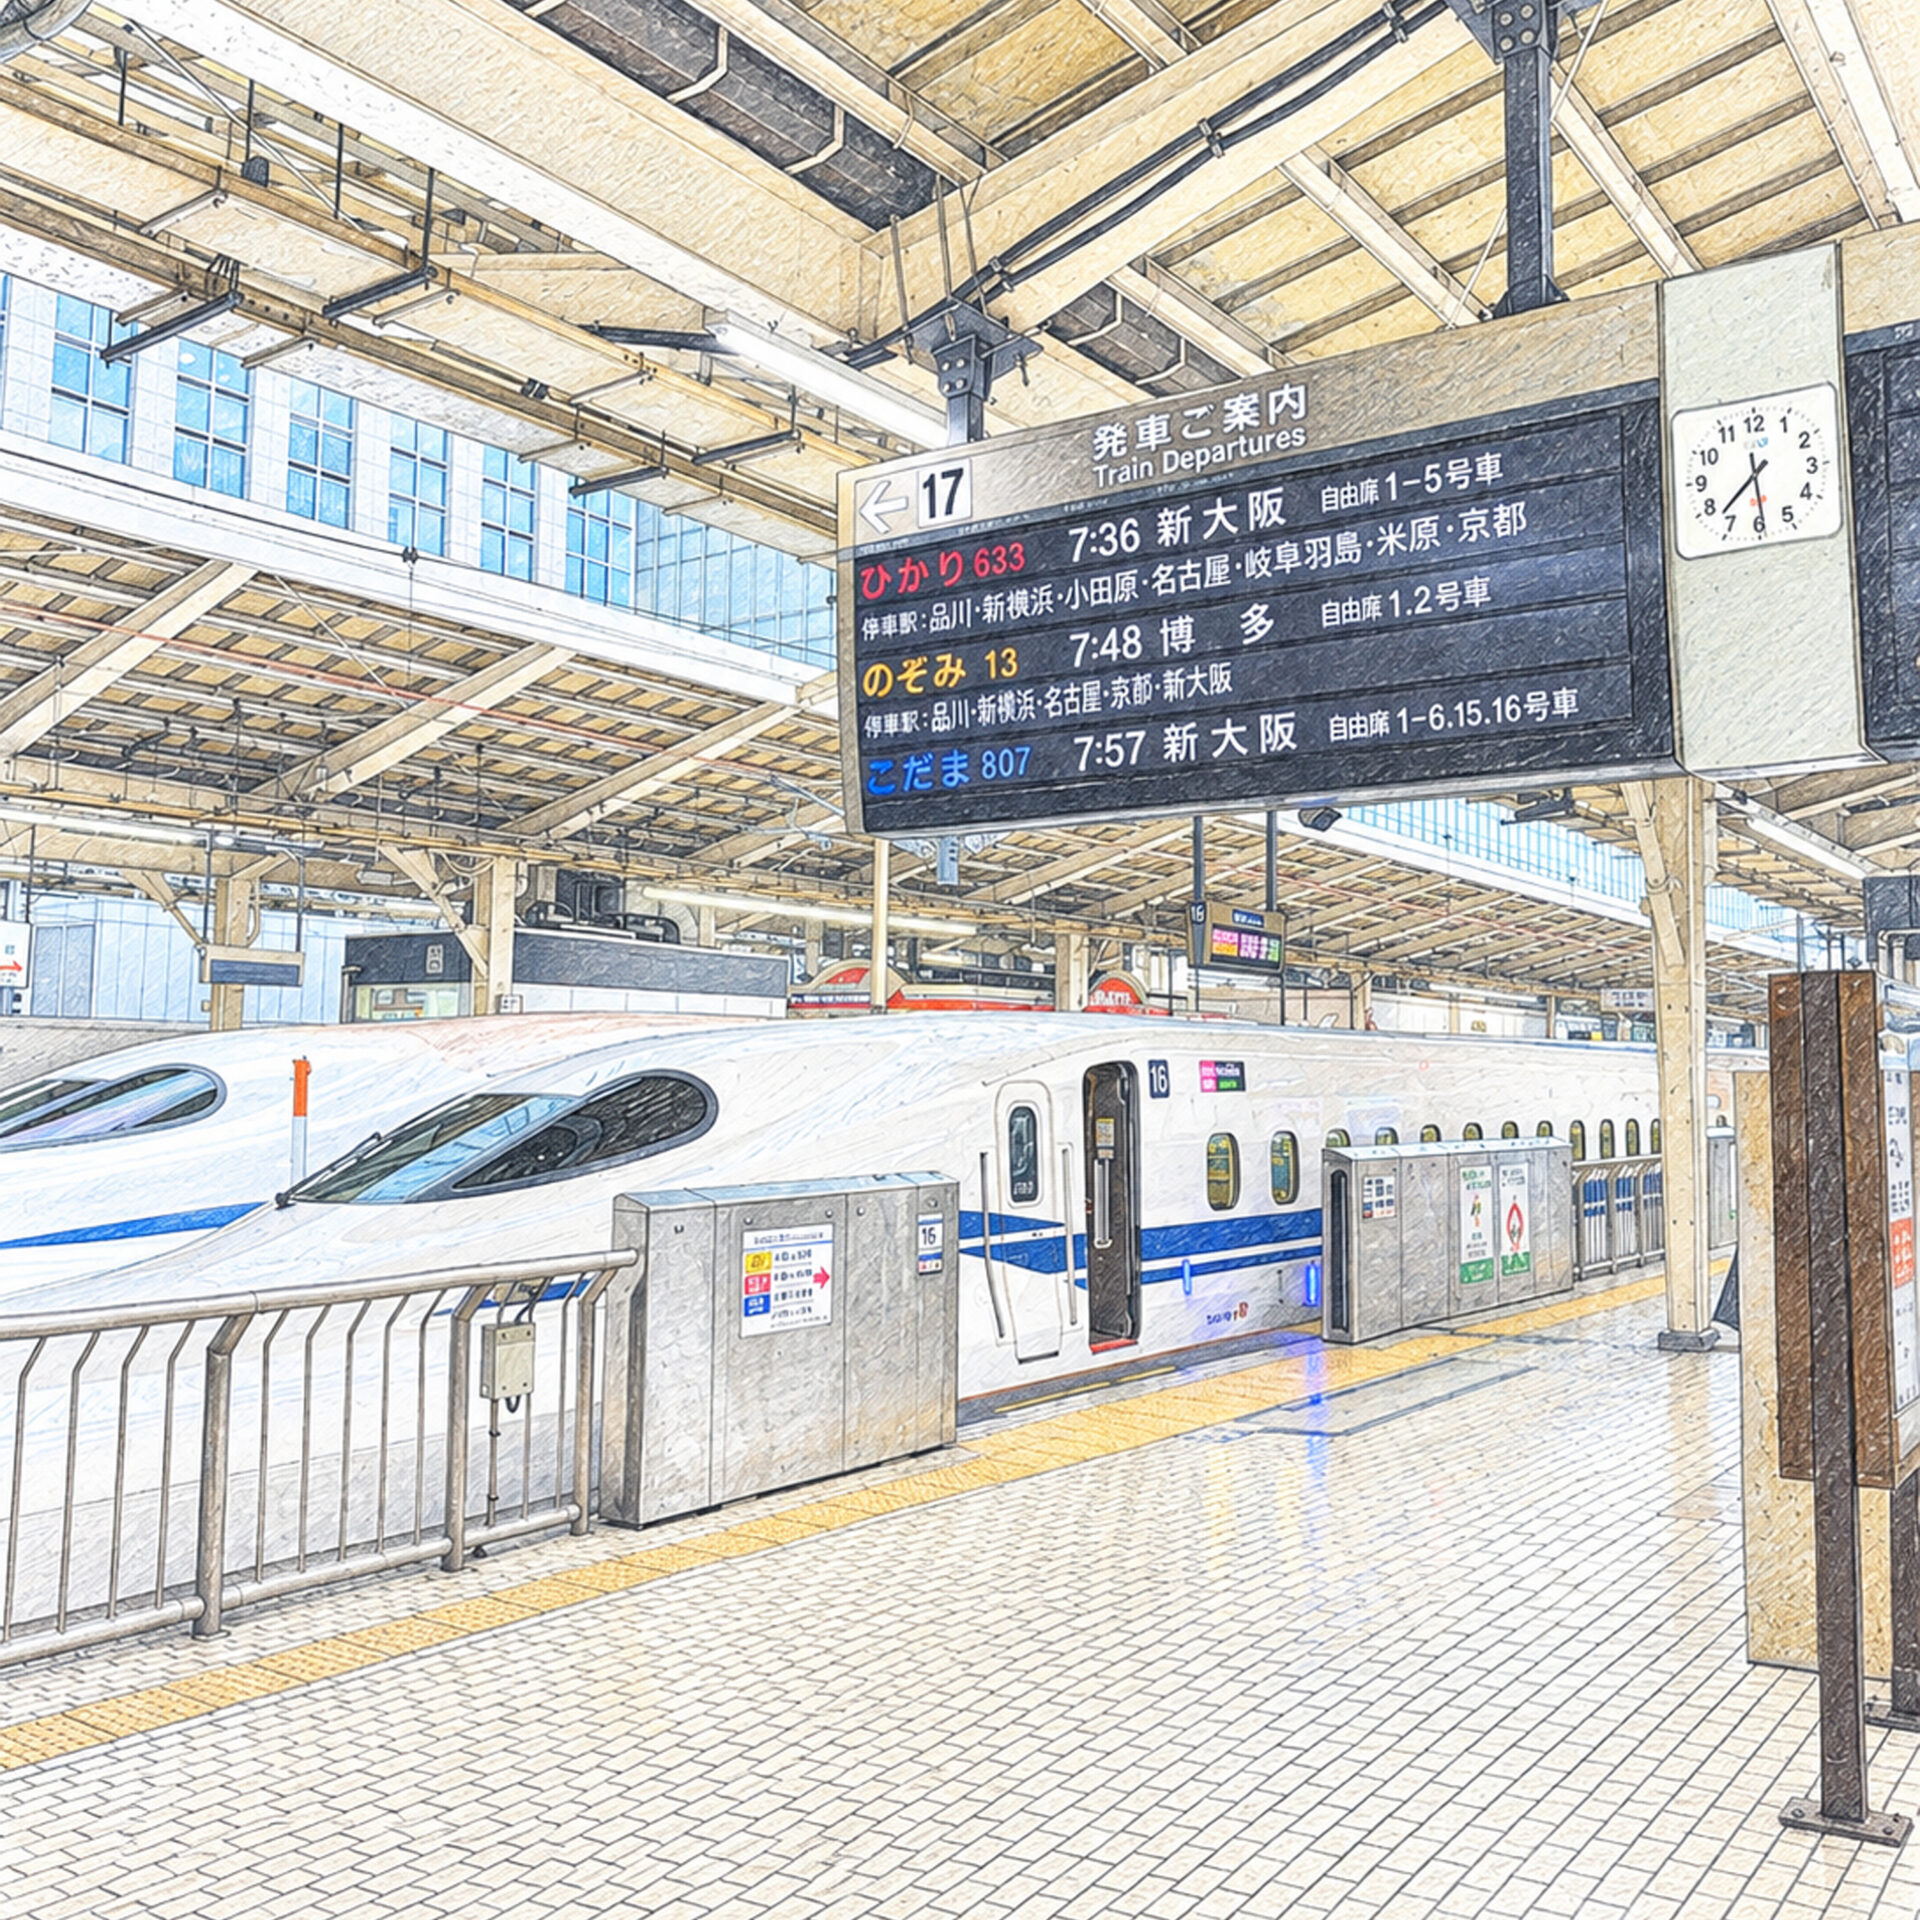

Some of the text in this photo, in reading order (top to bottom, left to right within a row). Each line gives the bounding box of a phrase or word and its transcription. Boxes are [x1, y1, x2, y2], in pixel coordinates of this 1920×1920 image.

[1092, 382, 1308, 461] 発車ご案内
[1744, 414, 1765, 433] 12
[1780, 416, 1788, 433] 1
[1718, 425, 1735, 443] 11
[1798, 431, 1811, 449] 2
[1093, 451, 1154, 488] Train
[1162, 424, 1307, 473] Departures
[1700, 448, 1719, 465] 10
[1806, 456, 1818, 474] 3
[1695, 475, 1707, 492] 9
[1799, 482, 1812, 500] 4
[921, 467, 965, 519] 17
[1704, 498, 1716, 516] 8
[1781, 506, 1794, 523] 5
[1724, 515, 1736, 532] 7
[1753, 516, 1766, 533] 6
[860, 550, 964, 600] ひかり
[973, 542, 1026, 577] 633
[1068, 517, 1142, 563] 7:36
[1157, 486, 1287, 547] 新大阪
[863, 652, 966, 698] のぞみ
[984, 647, 1019, 680] 13
[1069, 625, 1143, 668] 7:48
[867, 750, 970, 795] こだま
[981, 746, 1031, 779] 807
[1074, 730, 1146, 772] 7:57
[1163, 711, 1297, 763] 新大阪
[1191, 905, 1205, 922] 16
[1150, 1065, 1168, 1093] 16
[921, 1227, 936, 1245] 16
